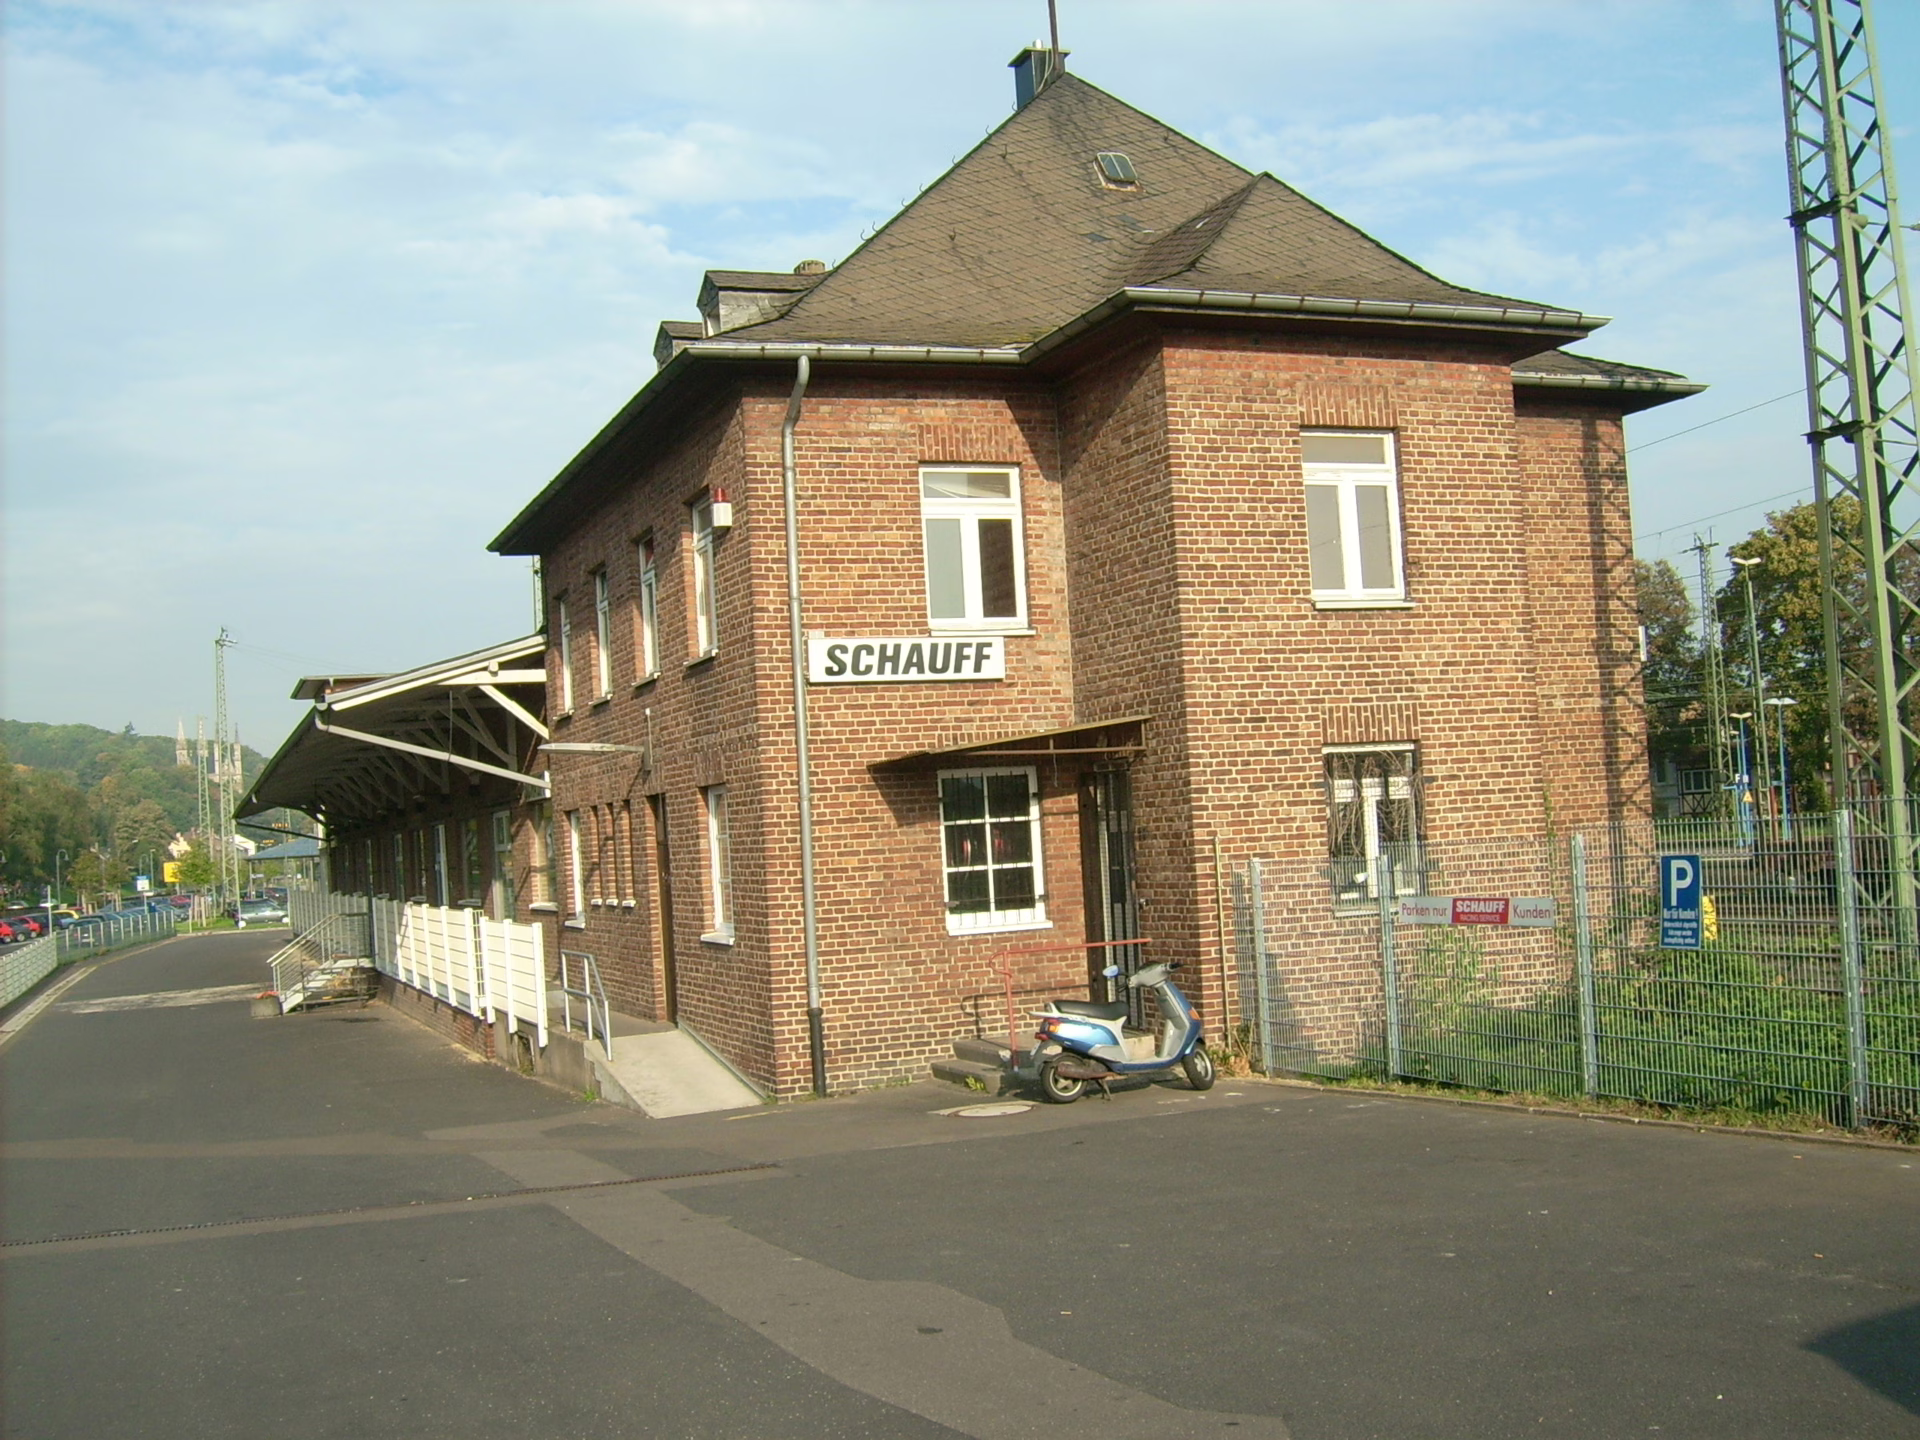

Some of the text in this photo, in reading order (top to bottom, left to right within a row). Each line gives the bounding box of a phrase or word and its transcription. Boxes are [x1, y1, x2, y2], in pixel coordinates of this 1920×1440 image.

[825, 642, 993, 677] SCHAUFF
[1671, 859, 1693, 906] P
[1402, 900, 1550, 919] Parken nur SCHAUFF Kunden
